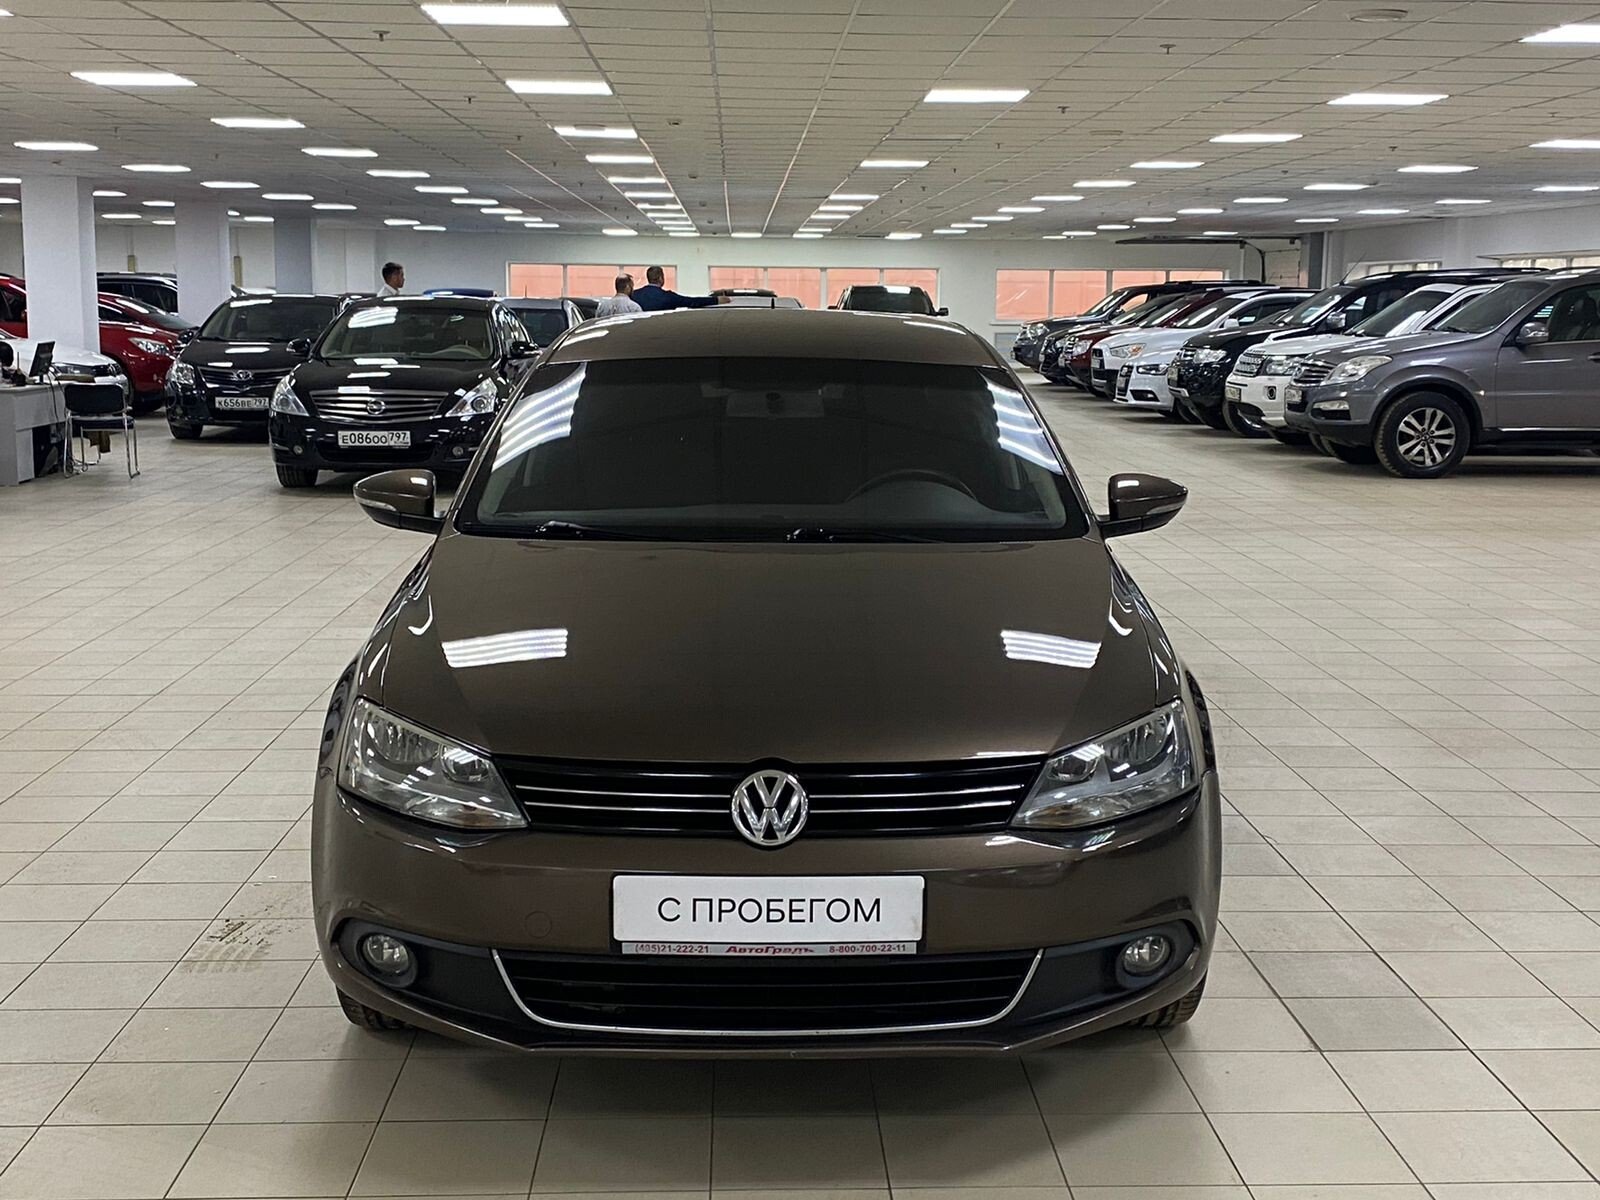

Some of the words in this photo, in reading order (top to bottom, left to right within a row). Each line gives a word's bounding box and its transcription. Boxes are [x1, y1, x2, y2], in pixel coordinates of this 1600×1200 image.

[388, 432, 407, 441] 797
[657, 897, 681, 922] С
[691, 897, 881, 923] ПРОБЕГОМ
[828, 944, 907, 954] 8-800-700-22-11
